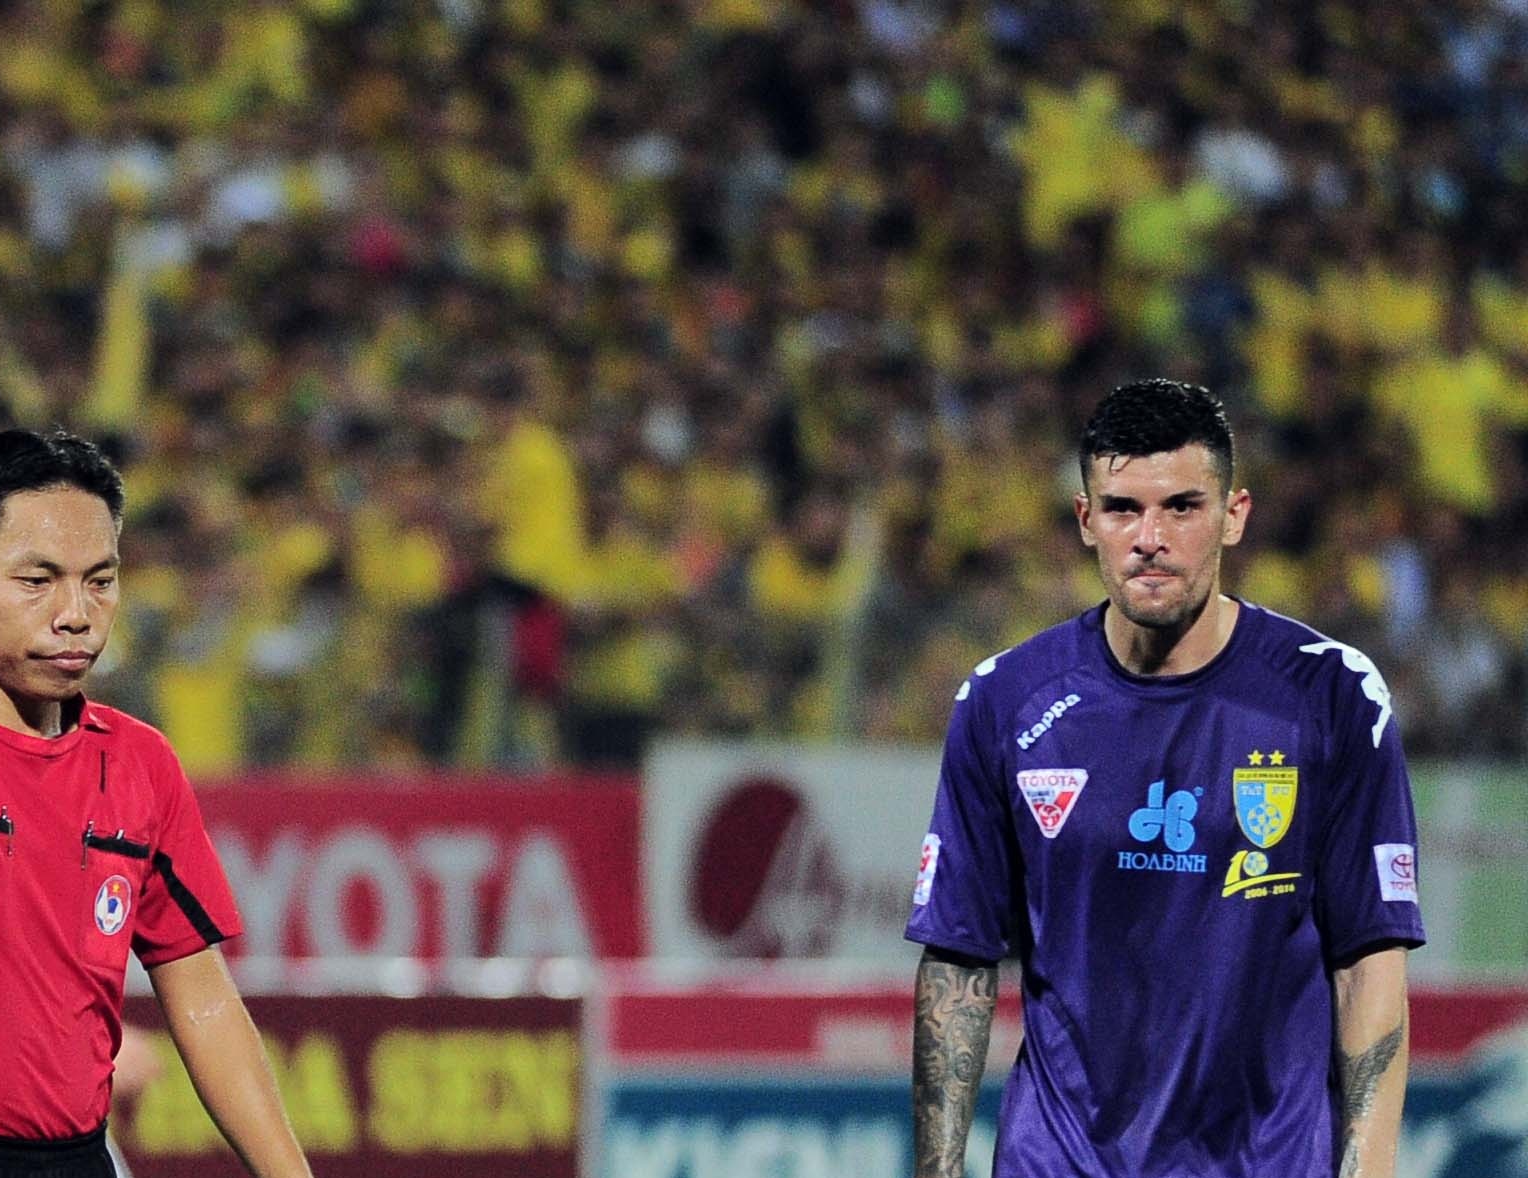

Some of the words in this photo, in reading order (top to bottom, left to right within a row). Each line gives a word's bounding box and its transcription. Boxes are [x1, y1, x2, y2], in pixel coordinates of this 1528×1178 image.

[1017, 694, 1081, 750] Kappa
[1021, 775, 1079, 788] TOYOTA
[1118, 851, 1207, 873] HOABINH
[210, 824, 602, 972] YOTA
